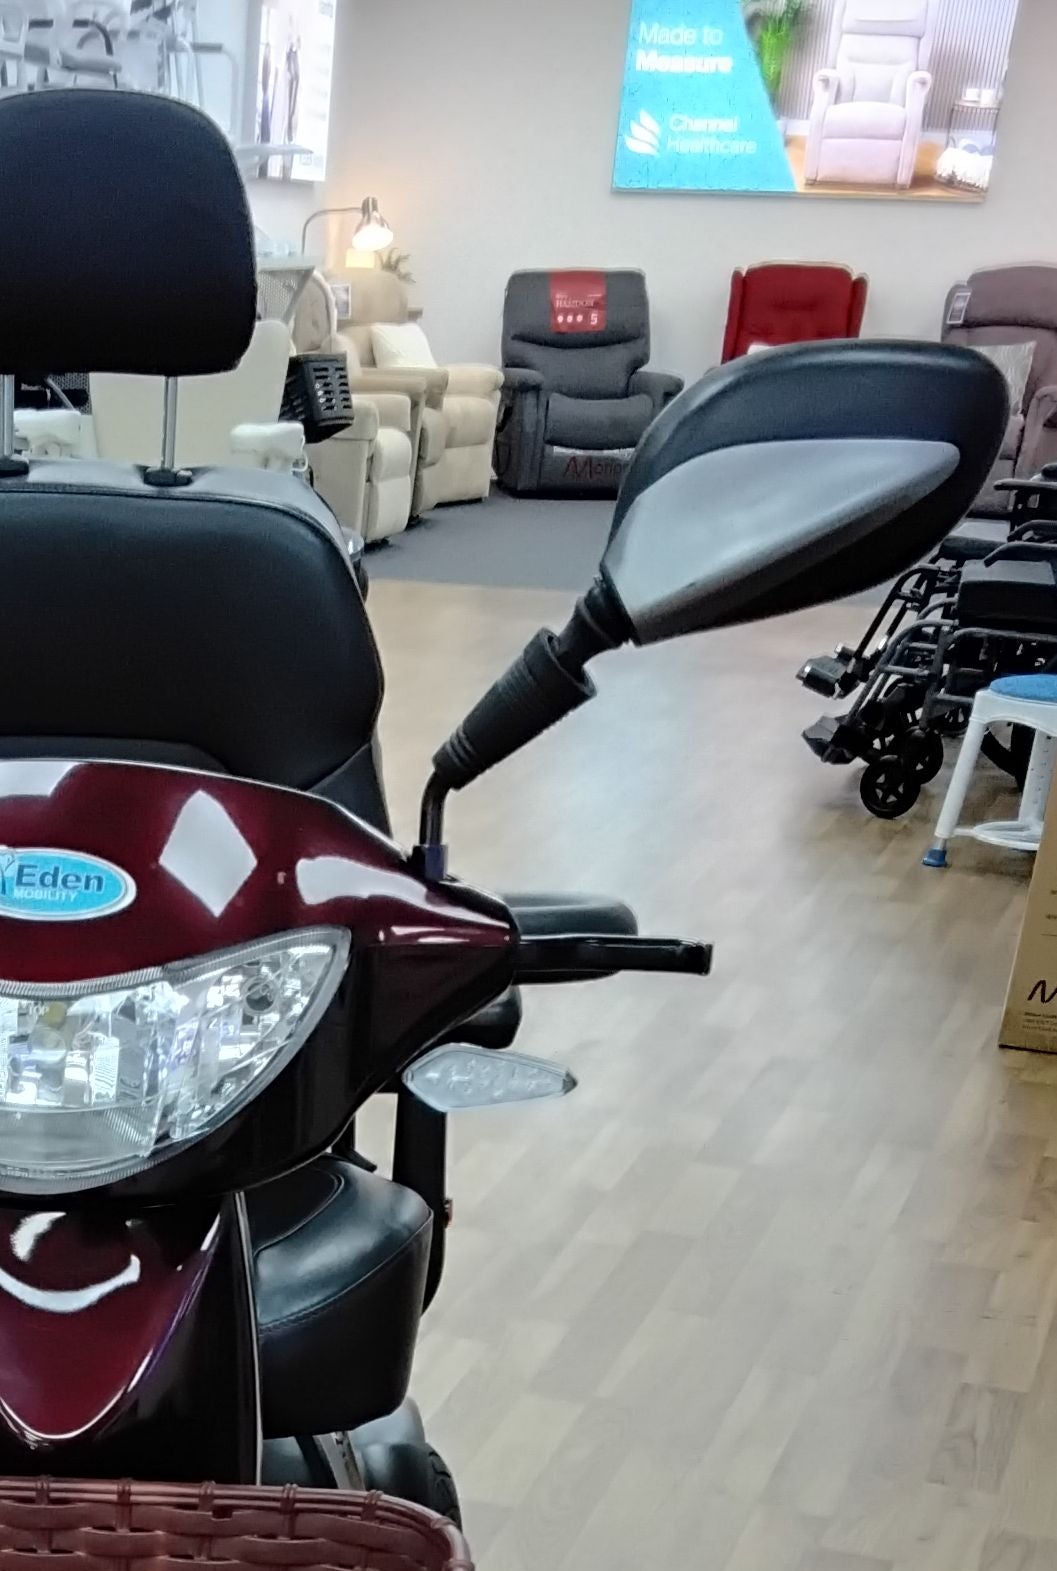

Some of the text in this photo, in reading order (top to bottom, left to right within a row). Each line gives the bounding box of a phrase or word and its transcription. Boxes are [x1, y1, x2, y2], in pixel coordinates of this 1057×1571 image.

[638, 22, 724, 45] Made to
[635, 49, 733, 73] Measure
[669, 114, 738, 133] Channel
[667, 136, 757, 153] Healthcare
[16, 864, 104, 892] Eden
[13, 888, 79, 902] MOBILITY
